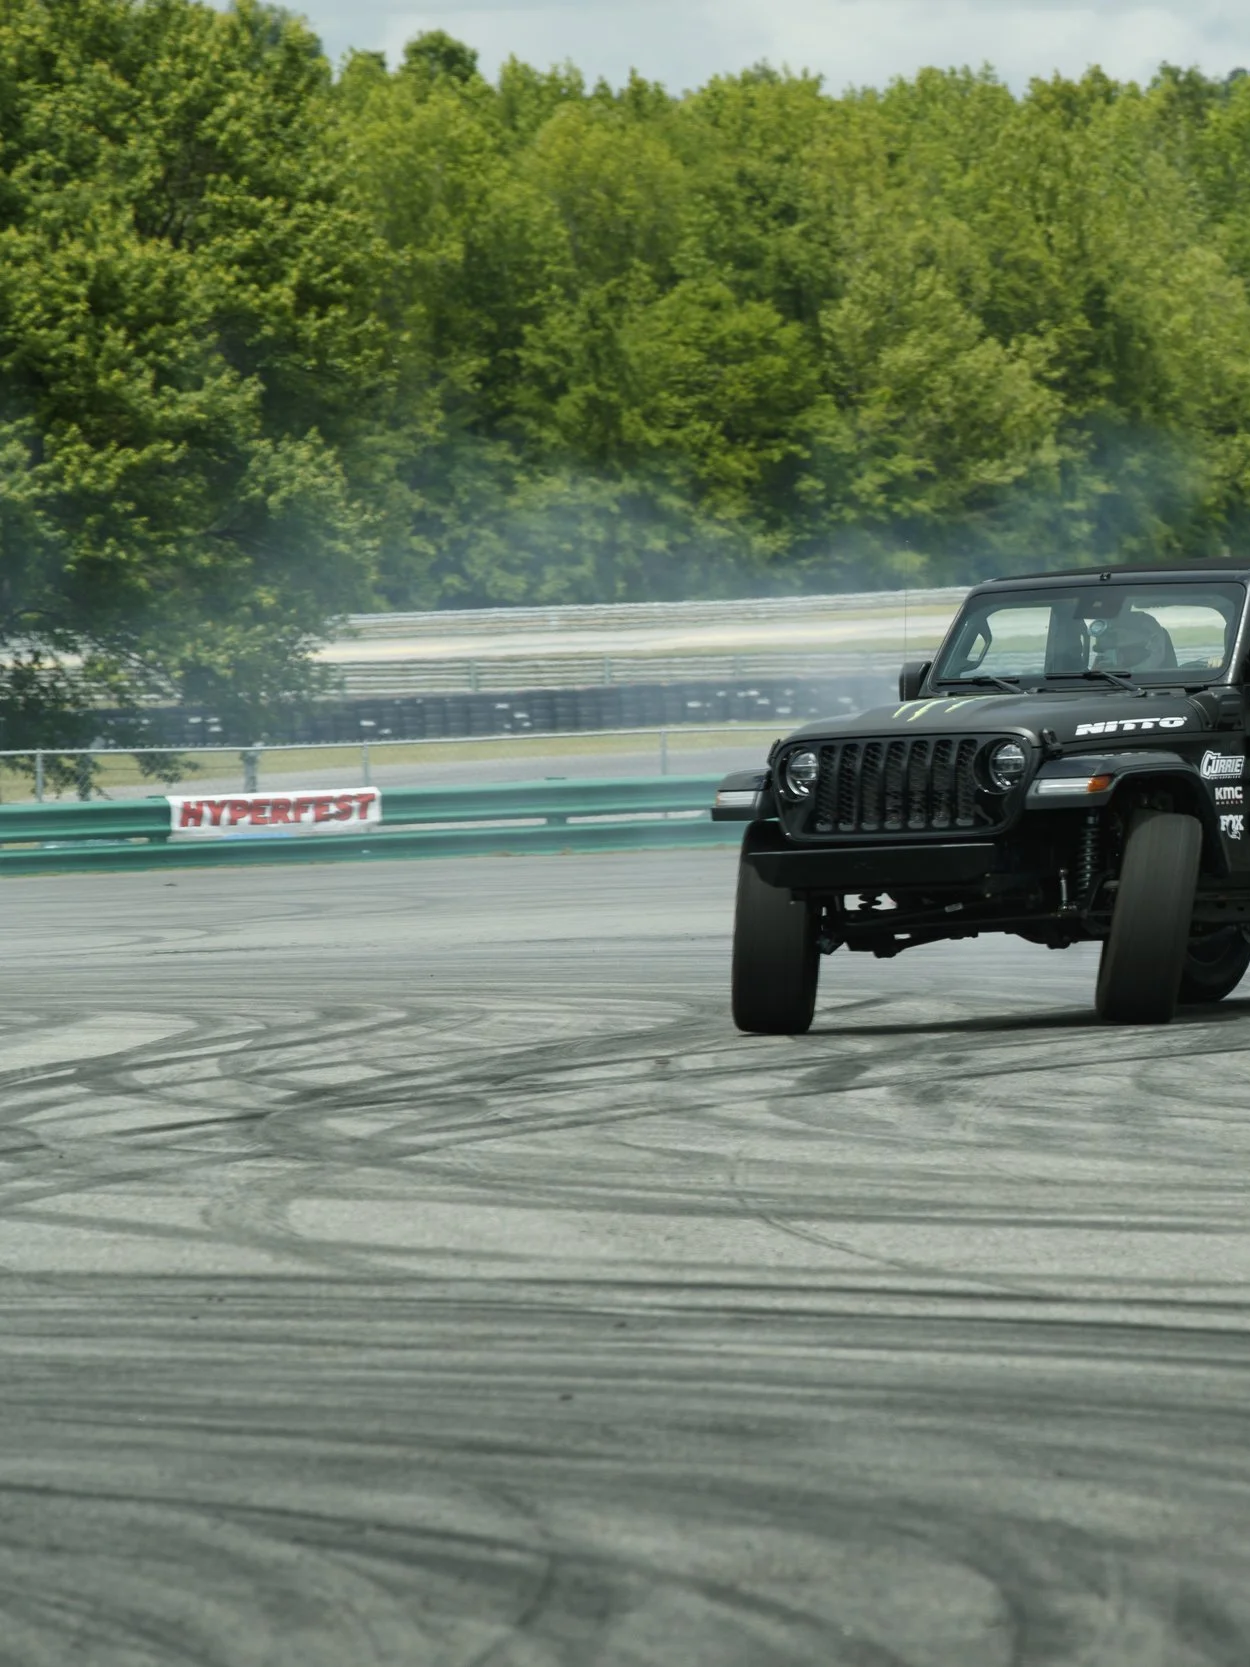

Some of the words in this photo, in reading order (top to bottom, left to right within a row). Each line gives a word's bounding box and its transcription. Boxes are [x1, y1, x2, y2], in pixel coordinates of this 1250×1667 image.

[1075, 716, 1186, 736] NITTO
[1202, 753, 1243, 776] CURRIE
[1214, 786, 1244, 800] KMC
[179, 793, 376, 828] HYPERFEST
[1219, 814, 1245, 840] FOX
